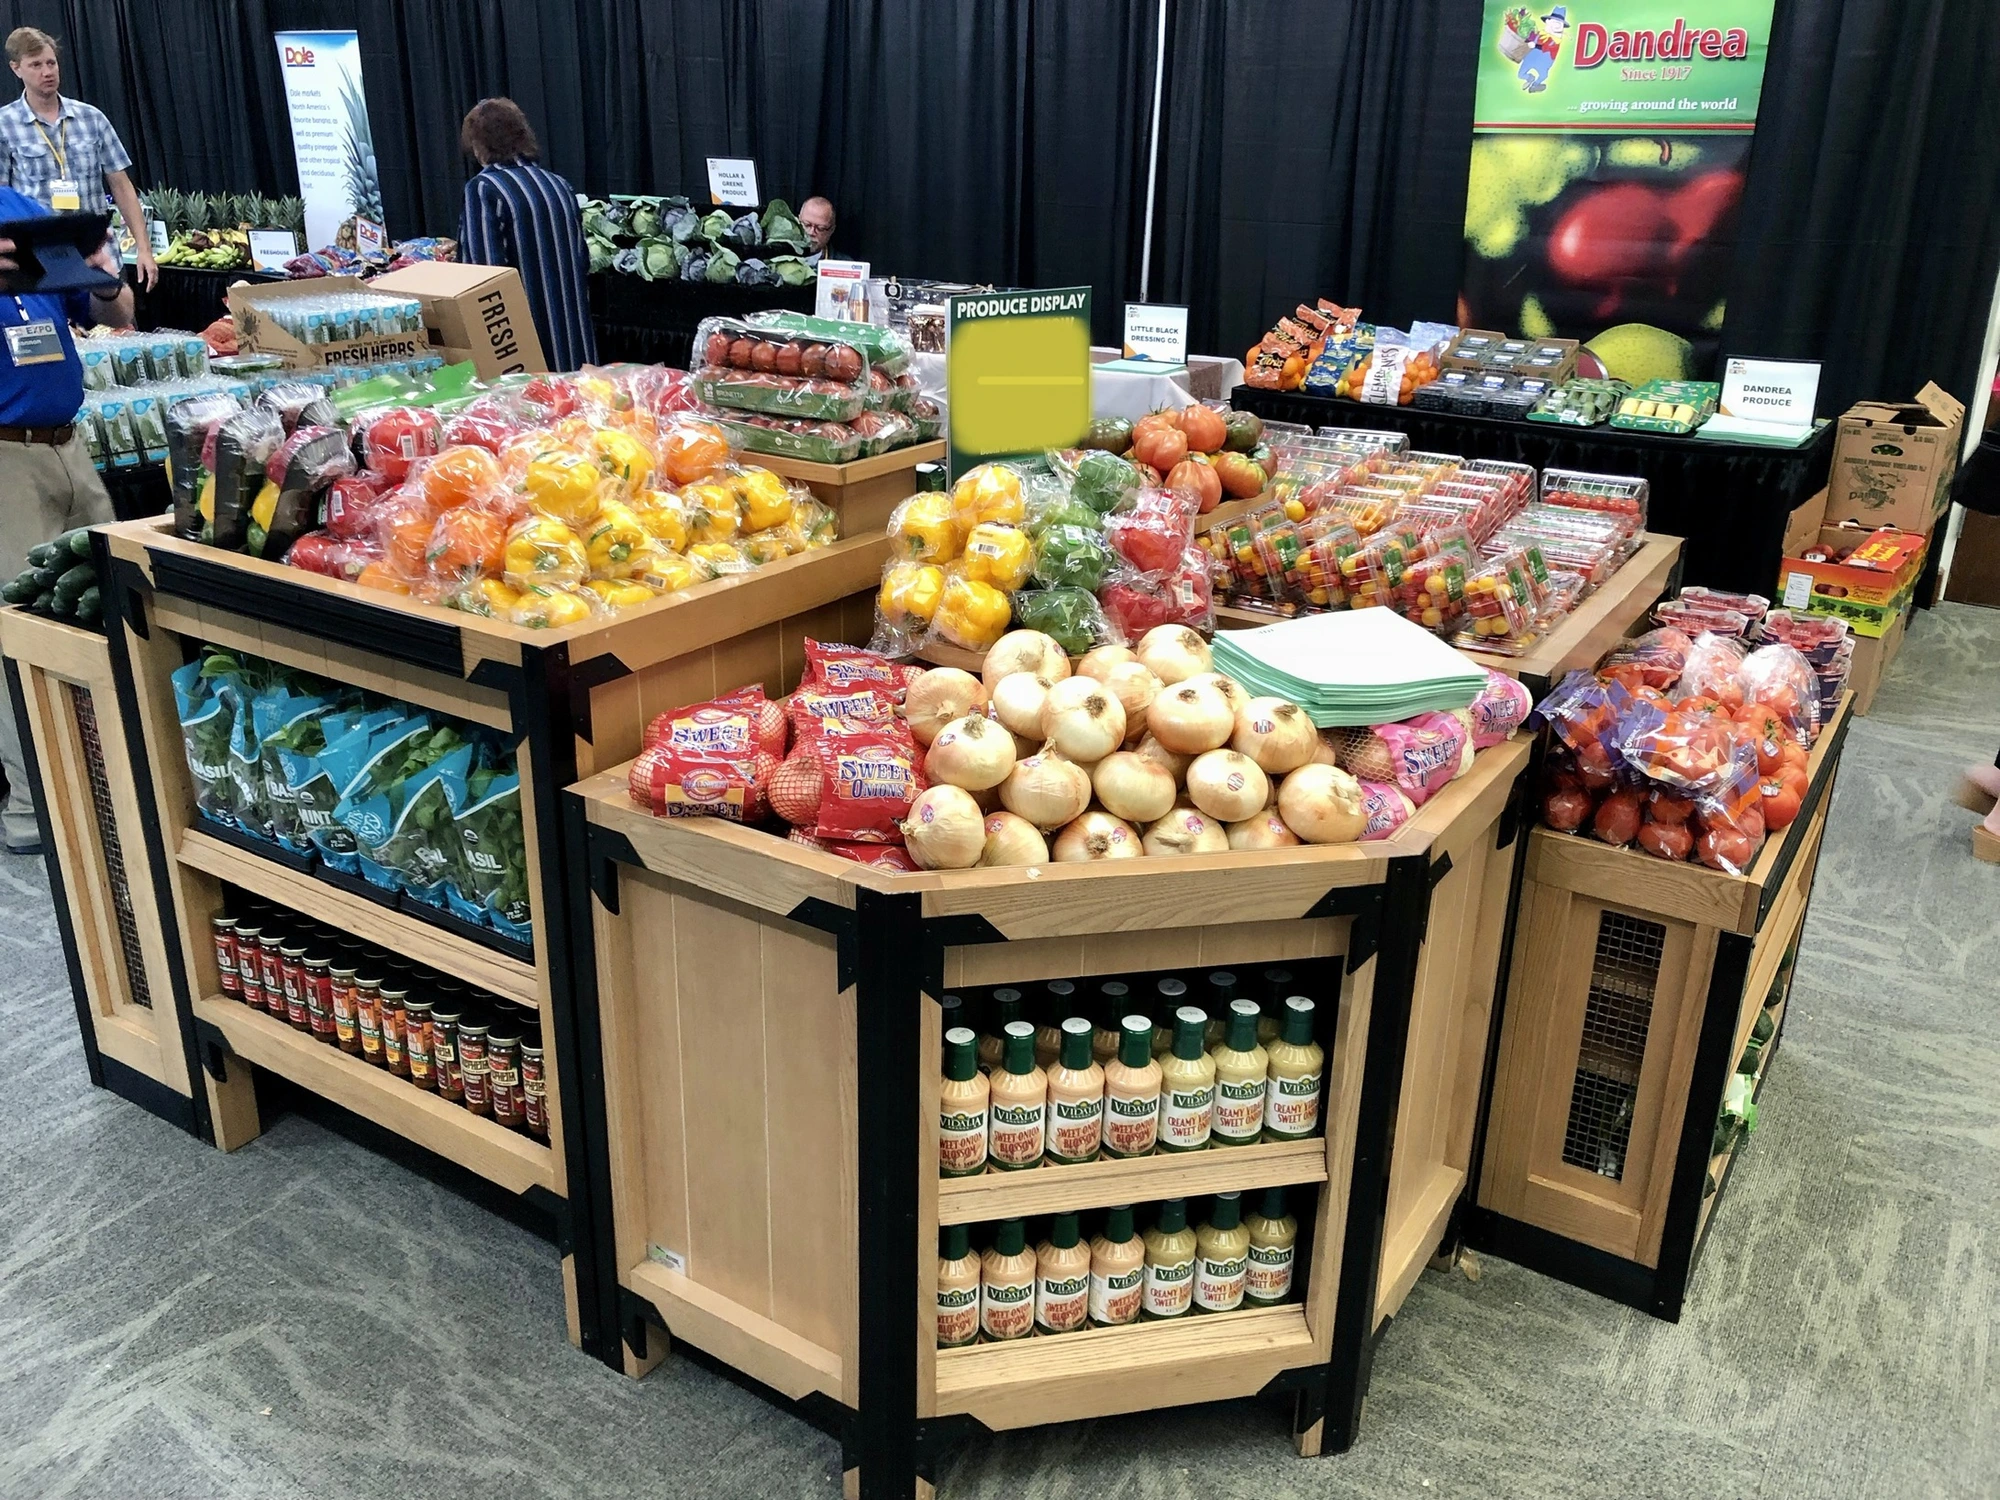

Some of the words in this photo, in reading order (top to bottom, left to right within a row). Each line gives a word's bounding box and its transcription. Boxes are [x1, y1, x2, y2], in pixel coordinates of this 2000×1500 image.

[1574, 17, 1747, 68] Dandrea
[285, 46, 315, 64] Dole
[1621, 66, 1657, 81] Since
[1661, 66, 1691, 81] 1917
[1580, 99, 1628, 113] growing
[1631, 99, 1675, 110] around
[1678, 98, 1698, 110] the
[1700, 97, 1737, 110] world
[360, 224, 378, 241] Dole
[957, 297, 1028, 319] PRODUCE
[1031, 293, 1086, 313] DISPLAY
[26, 325, 52, 334] EXPO
[477, 290, 518, 360] FRESH
[1131, 335, 1165, 343] DRESSING
[324, 347, 368, 365] FRESH
[1743, 385, 1792, 395] DANDREA
[1743, 396, 1792, 407] PRODUCE
[1482, 698, 1519, 722] SWEET
[674, 725, 746, 743] SWEET
[1404, 737, 1458, 775] SWEET
[192, 758, 232, 778] BASIL
[841, 760, 912, 783] SWEET
[852, 779, 905, 798] ONIONS
[668, 803, 740, 817] SWEET
[300, 809, 331, 825] MINT
[1058, 1103, 1101, 1117] VIDALIA
[1114, 1101, 1156, 1113] VIDALIA
[1216, 1105, 1245, 1117] CREAMY
[1274, 1103, 1302, 1114] CREAMY
[940, 1115, 981, 1128] VIDALIA
[996, 1109, 1040, 1121] VIDALIA
[1168, 1116, 1196, 1127] CREAMY
[1278, 1114, 1302, 1123] SWEET
[1110, 1122, 1134, 1134] SWEET
[1220, 1117, 1244, 1128] SWEET
[994, 1130, 1017, 1143] SWEET
[1018, 1126, 1040, 1142] ONION
[1056, 1127, 1080, 1139] SWEET
[1171, 1127, 1196, 1137] SWEET
[960, 1131, 982, 1148] ONION
[999, 1137, 1035, 1153] BLOSSOM
[1063, 1131, 1098, 1148] BLOSSOM
[942, 1144, 977, 1159] BLOSSOM
[1251, 1250, 1290, 1261] VIDALIA
[1048, 1278, 1088, 1293] VIDALIA
[1200, 1282, 1227, 1293] CREAMY
[990, 1287, 1032, 1300] VIDALIA
[1151, 1288, 1177, 1298] CREAMY
[1204, 1293, 1226, 1301] SWEET
[1045, 1301, 1068, 1312] SWEET
[1154, 1298, 1177, 1307] SWEET
[988, 1308, 1010, 1319] SWEET
